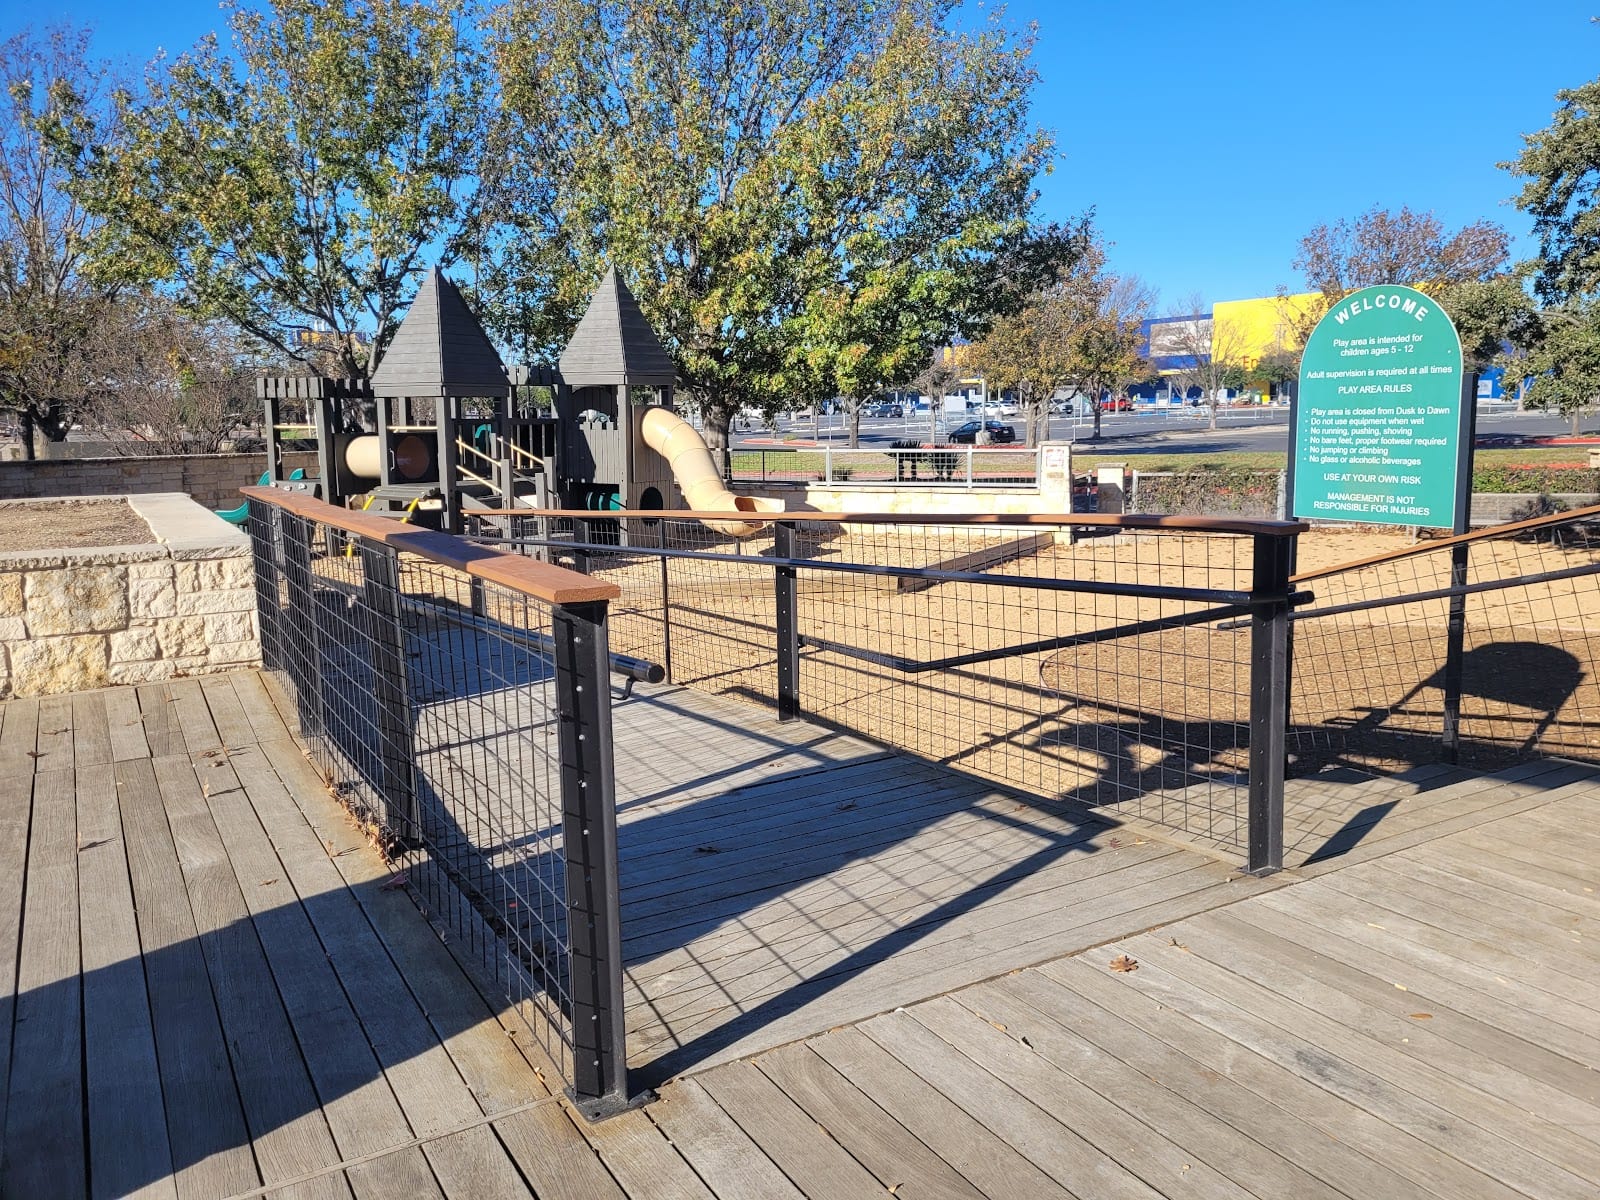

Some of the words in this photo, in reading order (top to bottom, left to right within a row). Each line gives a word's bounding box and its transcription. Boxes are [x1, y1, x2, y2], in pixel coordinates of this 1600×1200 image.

[1335, 295, 1429, 325] WELCOME
[1333, 339, 1349, 347] Play
[1351, 338, 1367, 346] area
[1369, 337, 1376, 345] is
[1377, 335, 1410, 344] intended
[1412, 334, 1423, 342] for
[1341, 348, 1369, 357] children
[1370, 348, 1389, 357] ages
[1404, 345, 1413, 353] 12
[1307, 371, 1324, 379] Adult
[1326, 369, 1366, 380] supervision
[1368, 368, 1374, 376] is
[1376, 366, 1407, 377] required
[1409, 366, 1418, 374] at
[1419, 366, 1429, 374] all
[1431, 365, 1452, 373] times
[1339, 385, 1359, 394] PLAY
[1360, 385, 1383, 393] AREA
[1384, 384, 1412, 393] RULES
[1311, 408, 1326, 417] Play
[1352, 407, 1376, 415] closed
[1378, 407, 1394, 415] from
[1349, 418, 1386, 427] equipment
[1388, 417, 1409, 425] when
[1411, 417, 1424, 425] wet
[1322, 428, 1349, 436] running,
[1351, 427, 1381, 436] pushing,
[1384, 427, 1412, 436] shoving
[1338, 437, 1353, 445] feet,
[1355, 438, 1378, 446] proper
[1381, 437, 1412, 445] footwear
[1415, 438, 1447, 447] required
[1320, 446, 1348, 455] jumping
[1359, 447, 1389, 456] climbing
[1309, 455, 1319, 463] No
[1320, 456, 1338, 465] glass
[1349, 456, 1380, 464] alcoholic
[1382, 457, 1421, 466] beverages
[1324, 473, 1340, 481] USE
[1353, 474, 1376, 482] YOUR
[1378, 475, 1398, 483] OWN
[1401, 476, 1421, 485] RISK
[1328, 492, 1385, 503] MANAGEMENT
[1397, 496, 1415, 504] NOT
[1314, 501, 1368, 512] RESPONSIBLE
[1371, 505, 1389, 513] FOR
[1391, 506, 1430, 516] INJURIES
